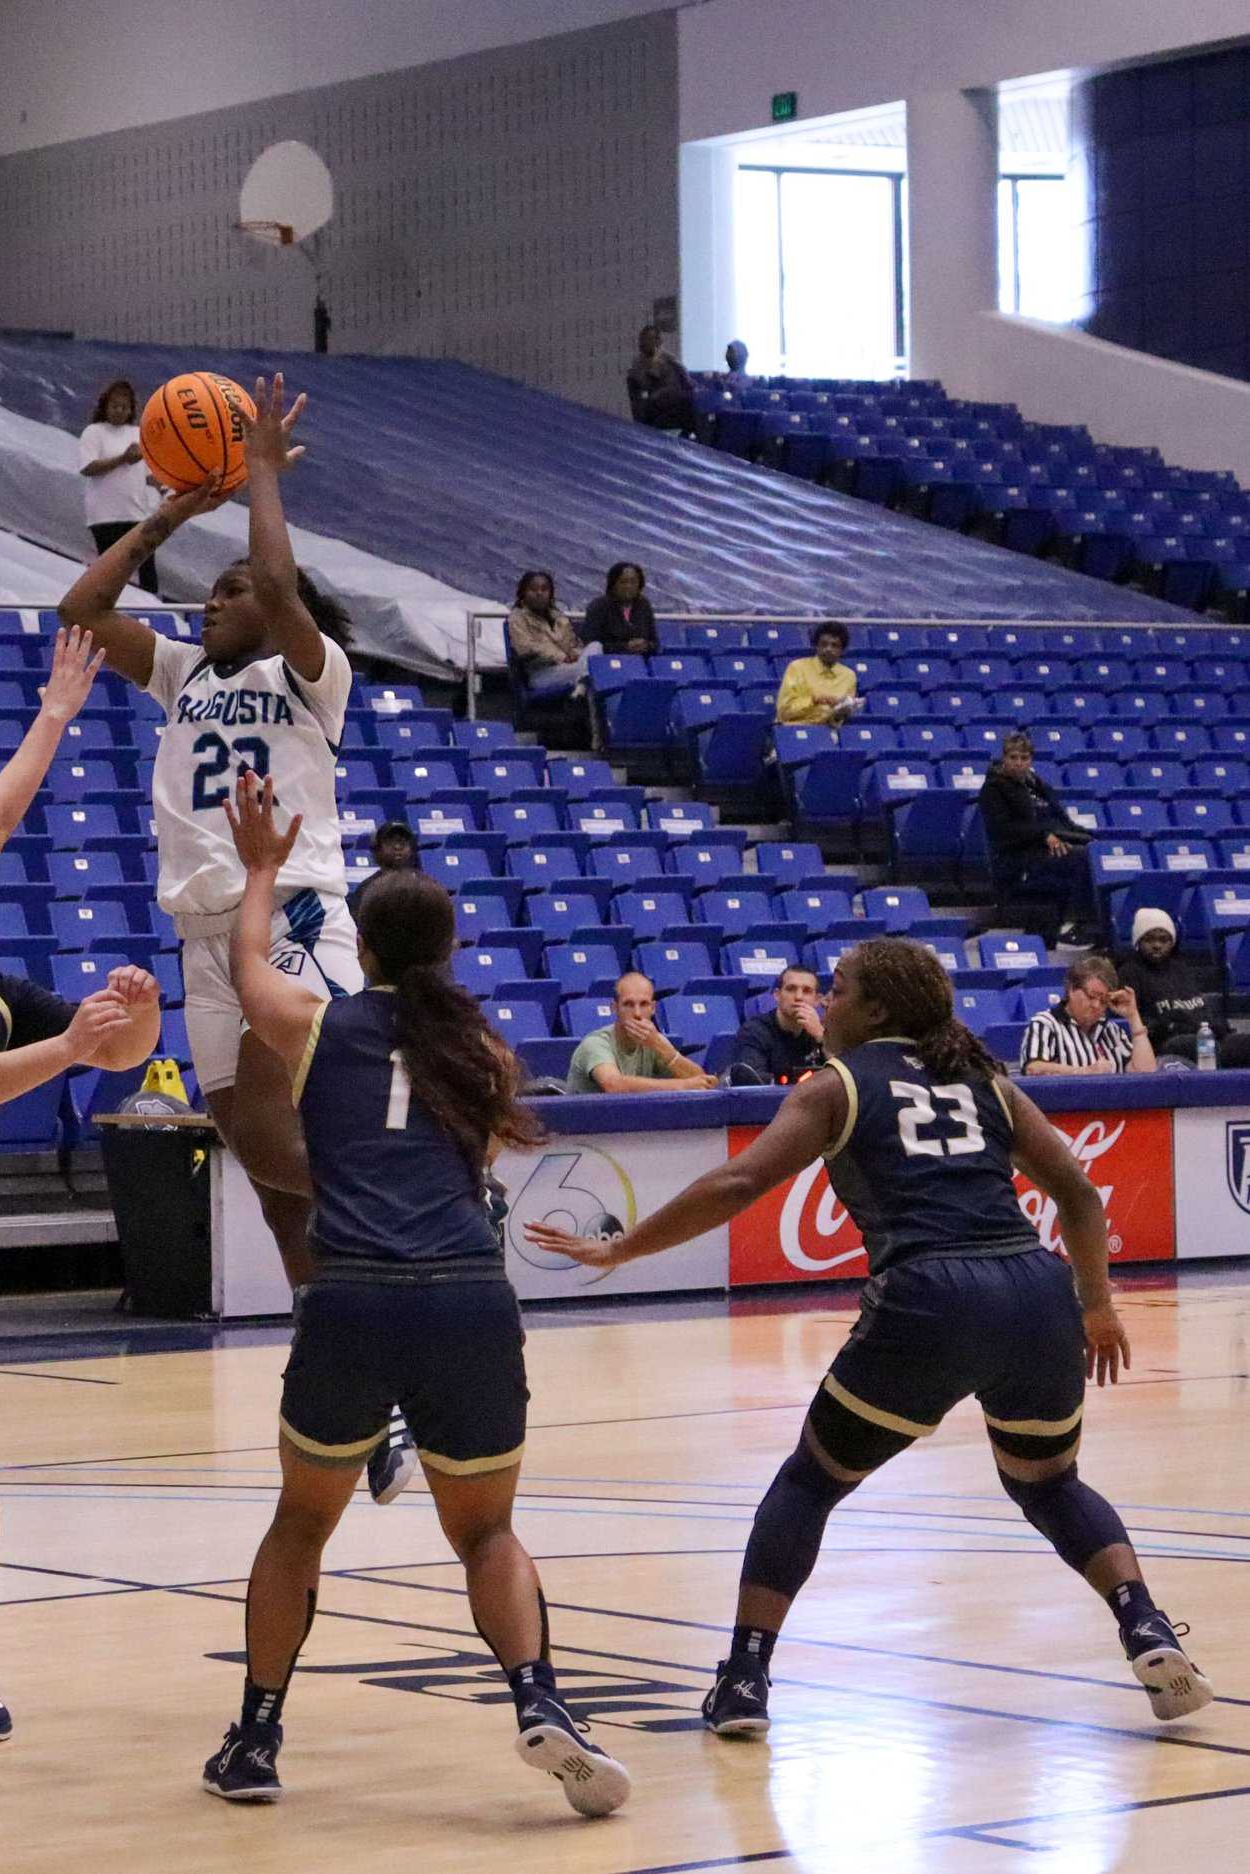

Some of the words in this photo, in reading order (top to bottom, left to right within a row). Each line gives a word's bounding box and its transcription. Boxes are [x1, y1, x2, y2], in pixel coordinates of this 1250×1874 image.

[177, 388, 209, 429] EVO
[386, 1049, 411, 1130] 1
[889, 1080, 986, 1157] 23
